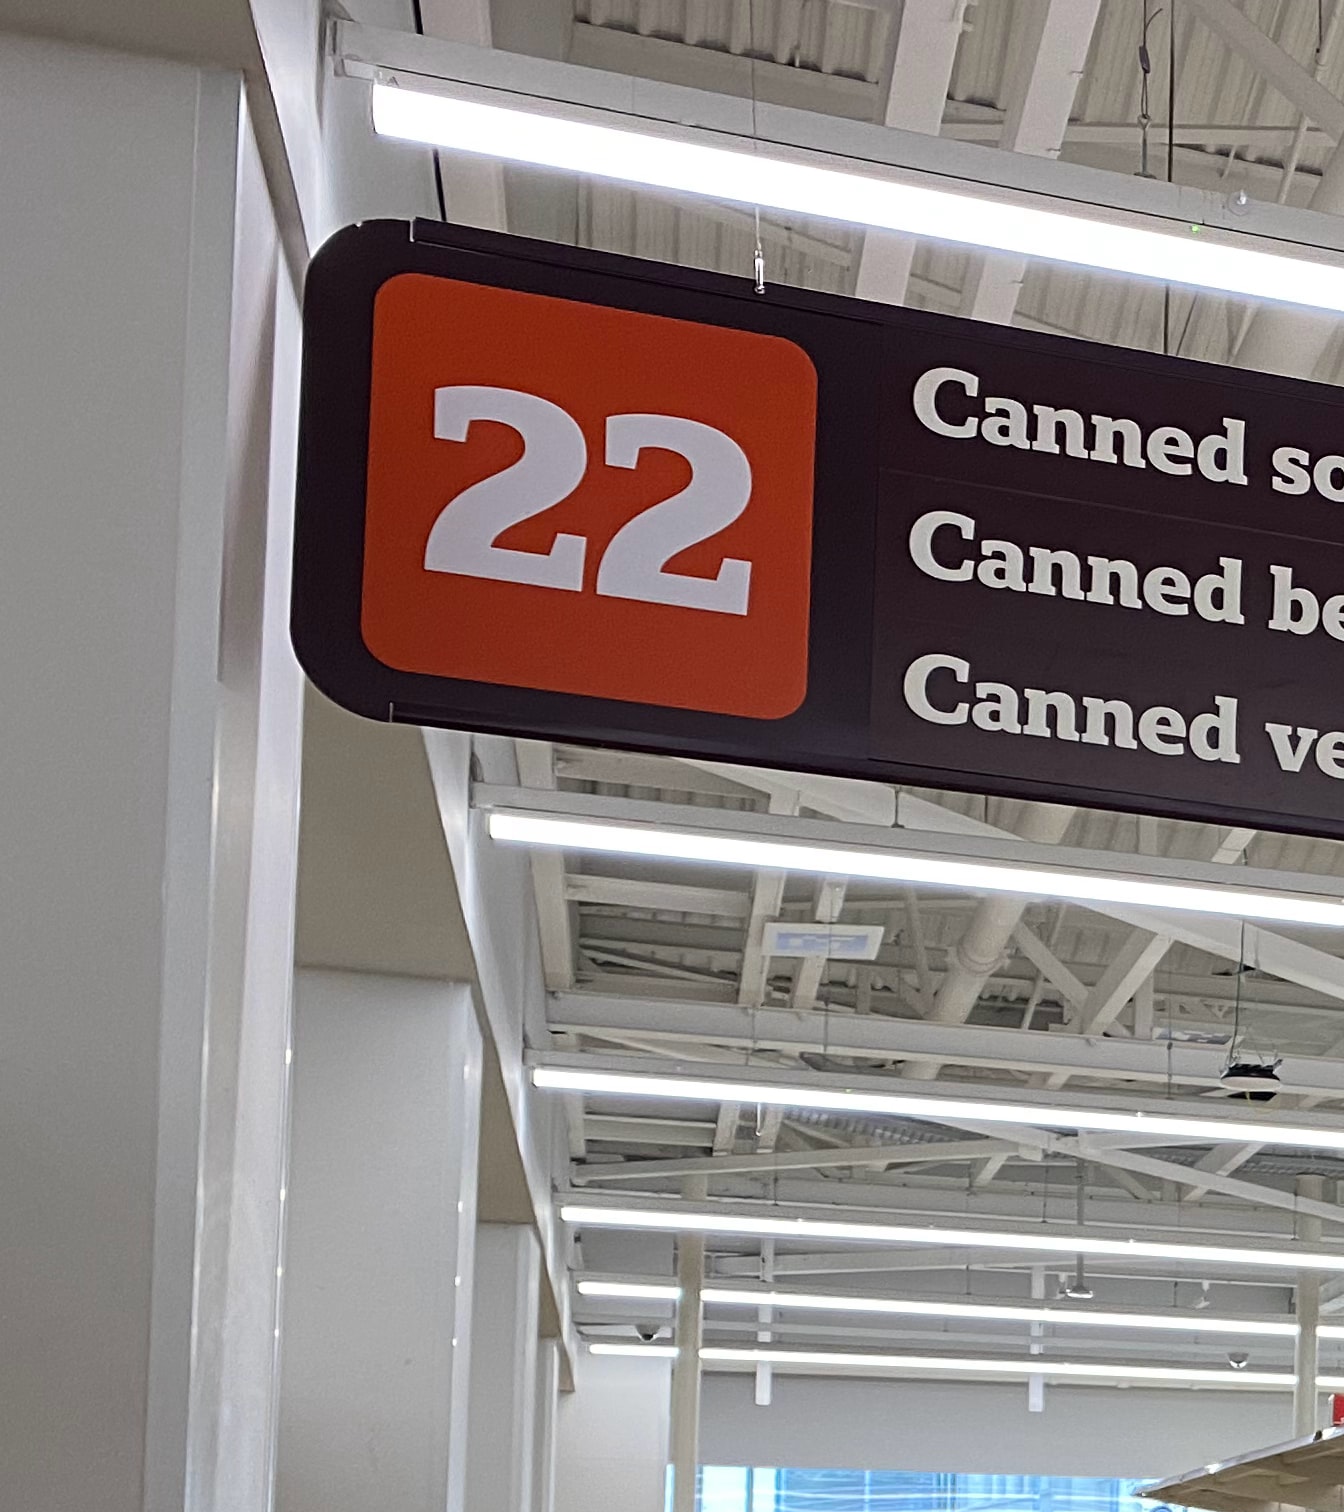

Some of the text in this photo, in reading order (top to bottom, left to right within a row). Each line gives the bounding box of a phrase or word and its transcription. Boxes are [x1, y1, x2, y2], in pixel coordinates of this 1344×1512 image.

[910, 368, 1247, 485] Canned
[425, 386, 751, 615] 22
[910, 511, 1244, 624] Canned
[905, 654, 1240, 763] Canned
